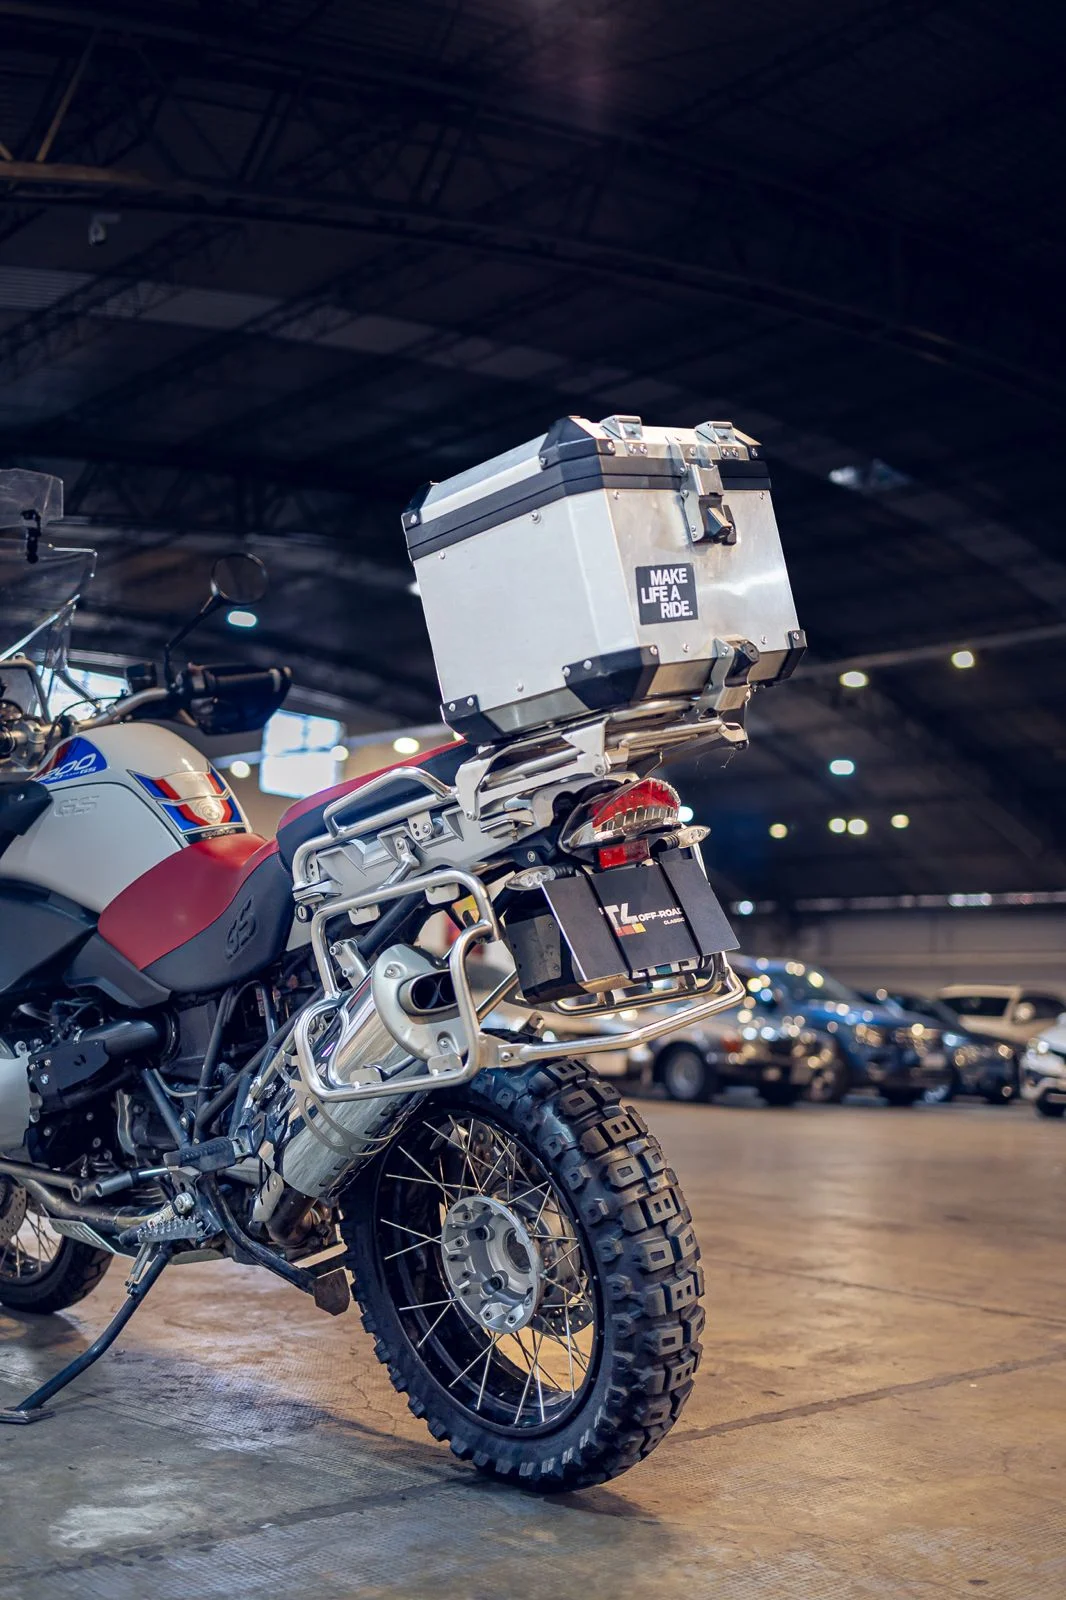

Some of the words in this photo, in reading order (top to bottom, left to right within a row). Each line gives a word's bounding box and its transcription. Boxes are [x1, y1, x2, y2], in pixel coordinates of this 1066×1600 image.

[650, 567, 688, 586] MAKE
[641, 586, 669, 604] LIFE
[670, 584, 681, 601] A
[660, 600, 693, 619] RIDE.
